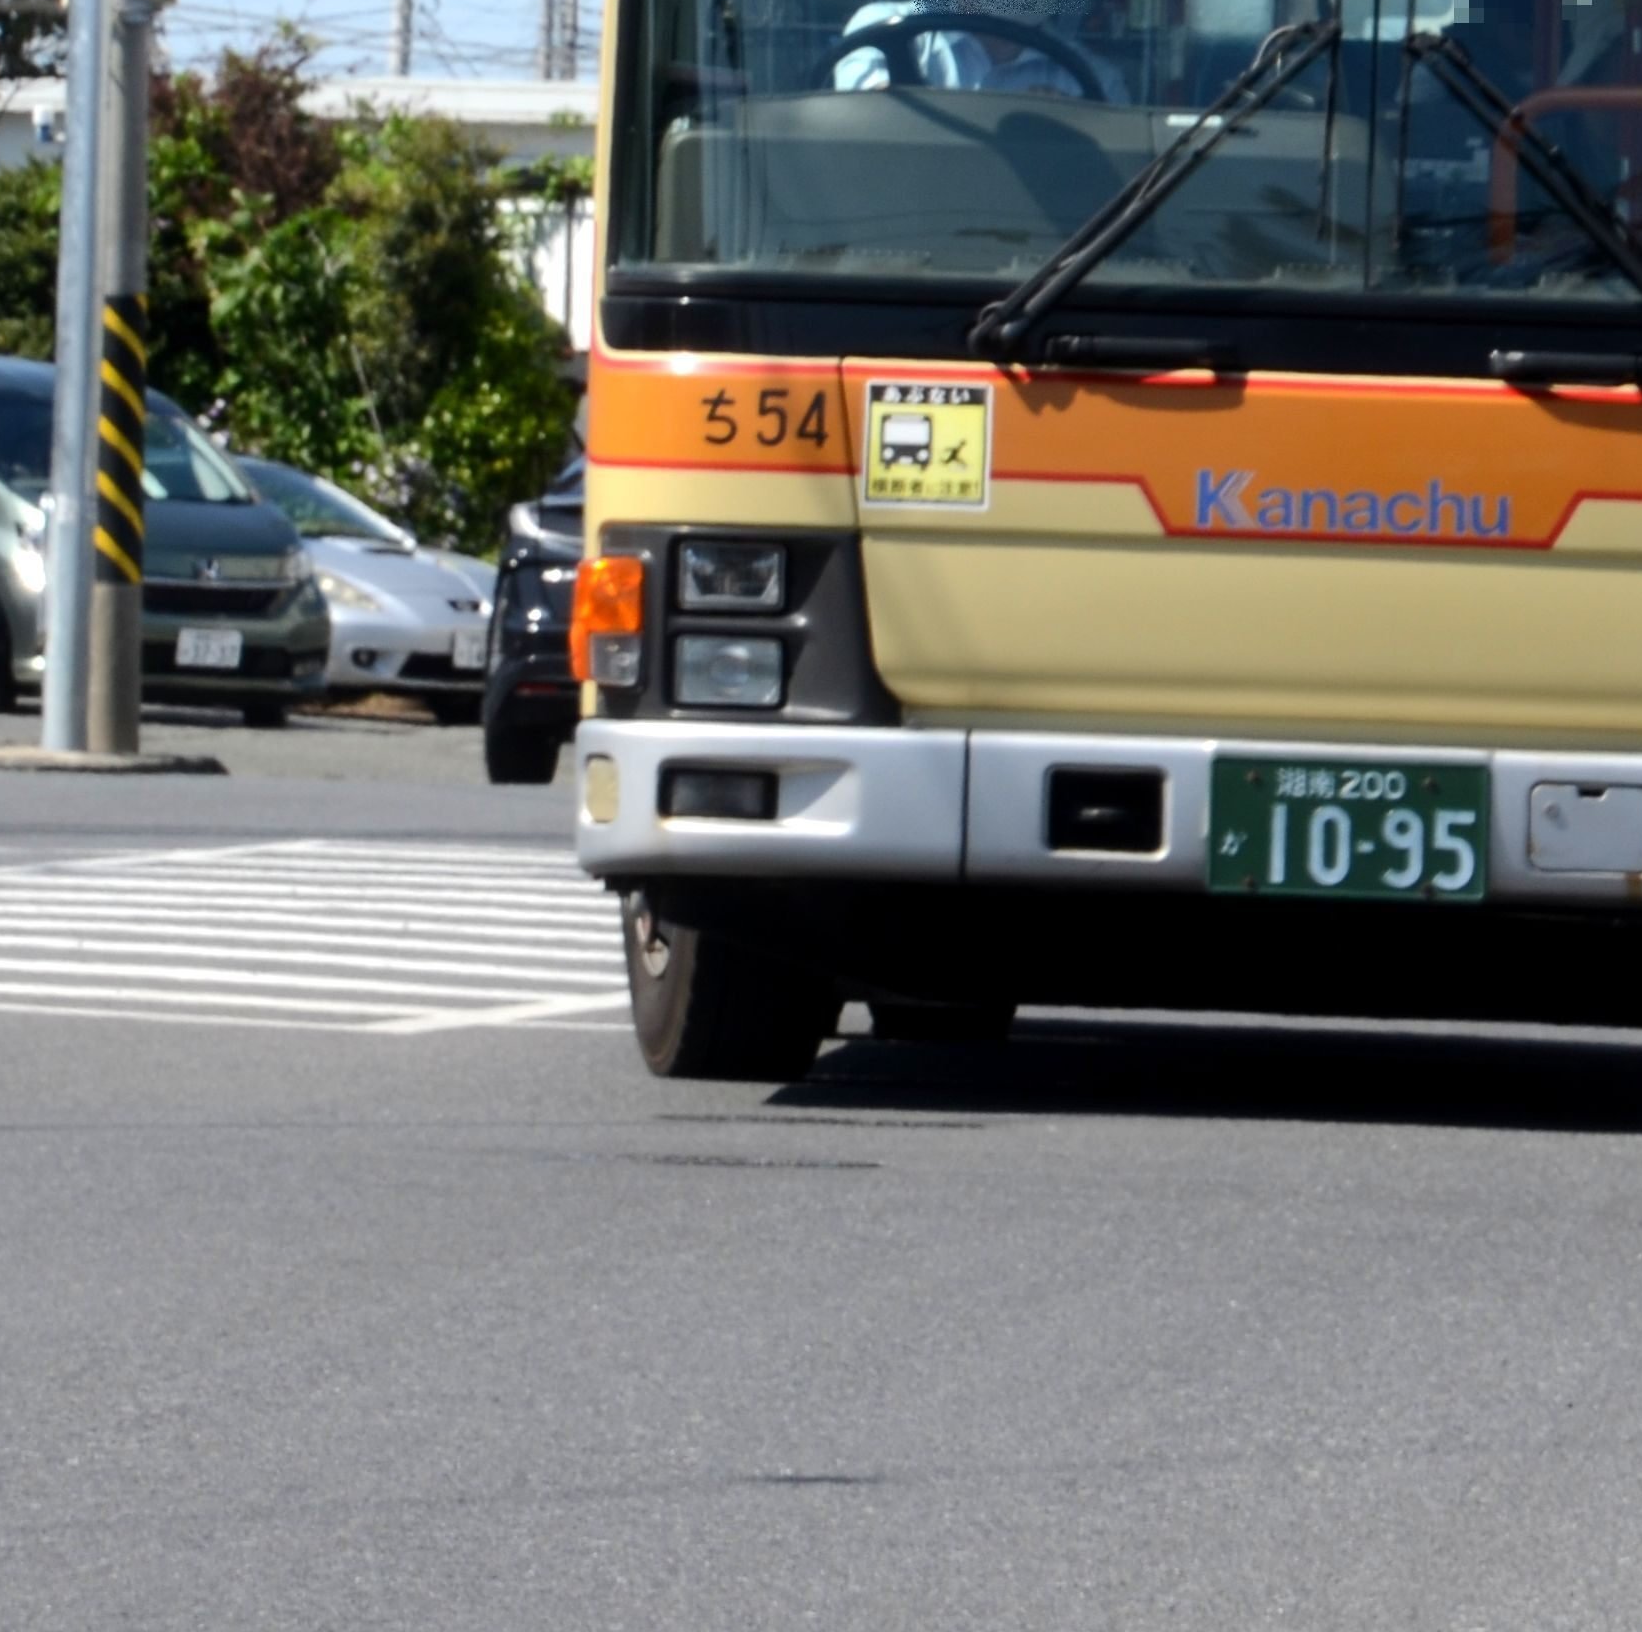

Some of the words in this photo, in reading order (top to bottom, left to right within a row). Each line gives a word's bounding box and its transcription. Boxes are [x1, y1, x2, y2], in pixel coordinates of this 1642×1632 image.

[882, 385, 971, 405] あぶない
[1195, 467, 1512, 537] Kanachu
[1266, 801, 1476, 891] 10-95
